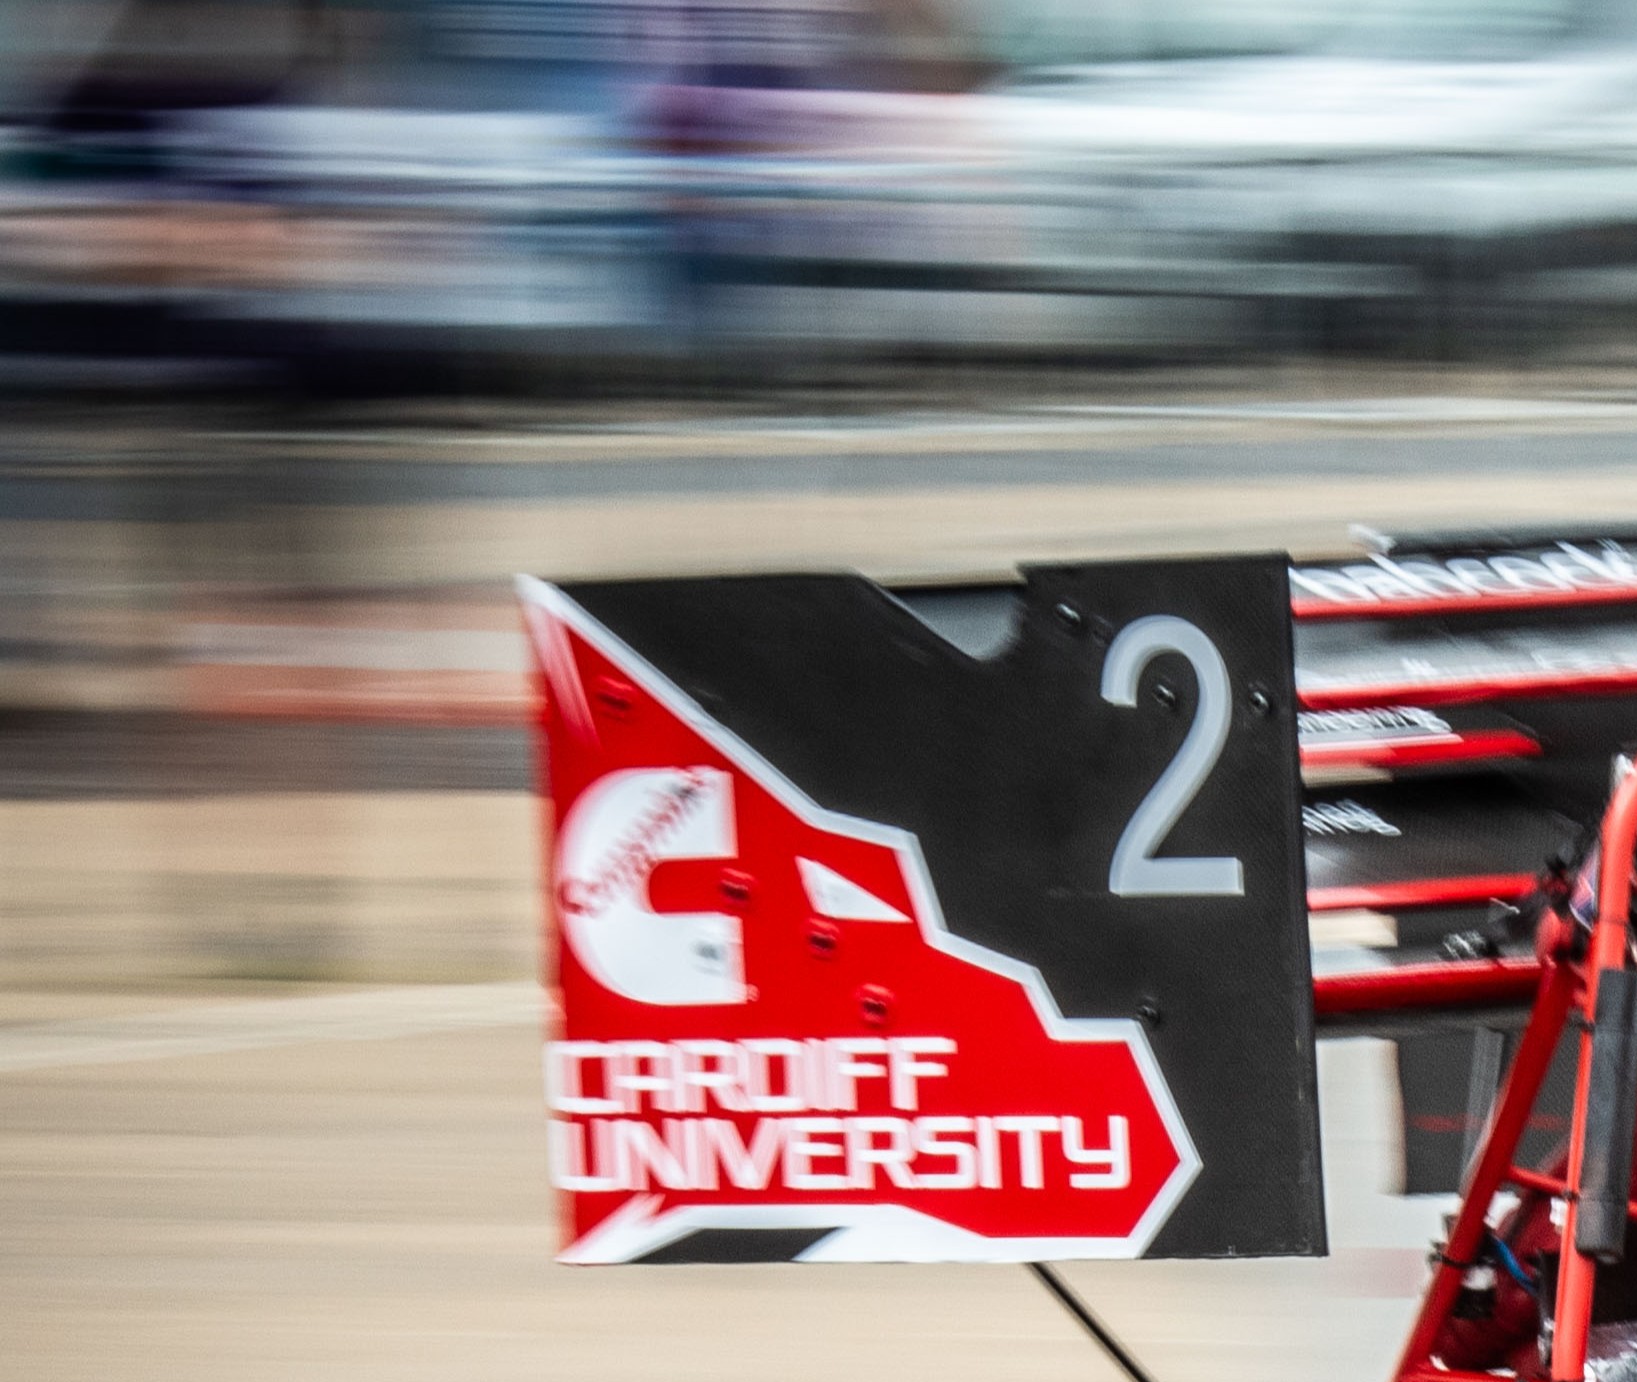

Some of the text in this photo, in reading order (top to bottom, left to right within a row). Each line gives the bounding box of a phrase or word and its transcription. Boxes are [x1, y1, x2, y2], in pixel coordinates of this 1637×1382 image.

[1100, 614, 1245, 897] 2
[545, 1036, 957, 1114] CARDIFF
[550, 1114, 1133, 1192] UNIVERSITY
